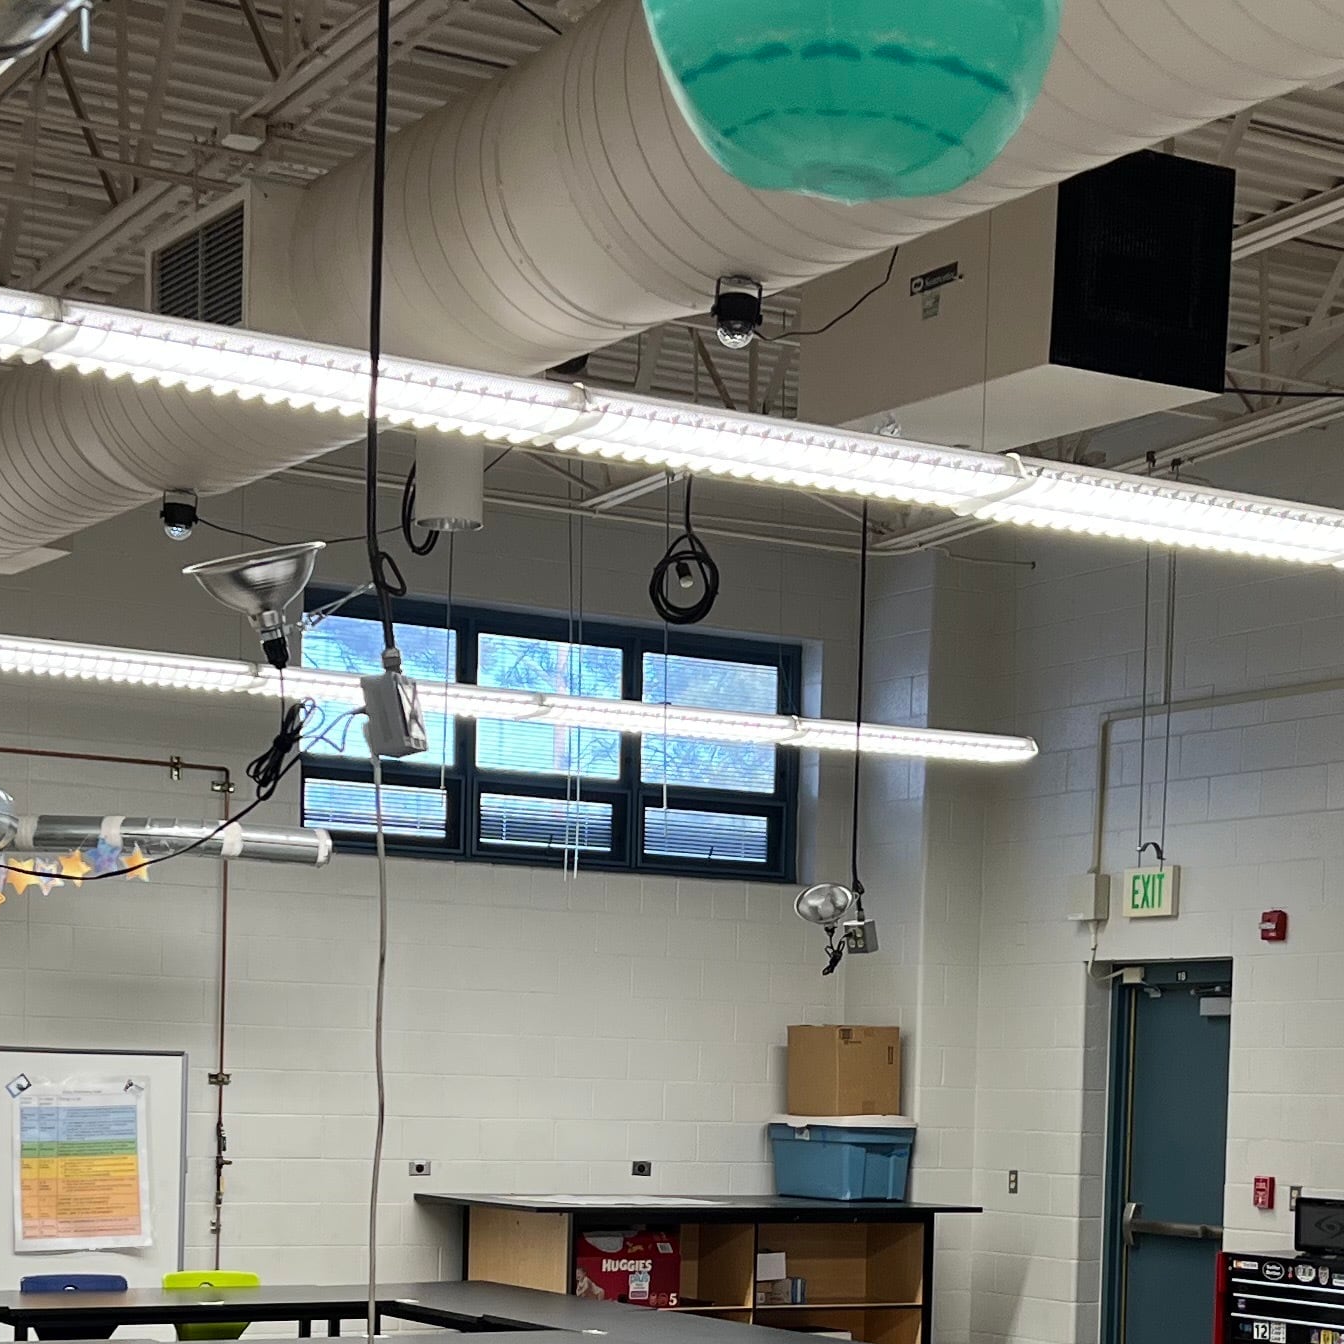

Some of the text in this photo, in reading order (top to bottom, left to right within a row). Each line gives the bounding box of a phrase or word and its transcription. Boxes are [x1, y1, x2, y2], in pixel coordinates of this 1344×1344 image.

[1131, 873, 1165, 909] EXIT
[602, 1259, 653, 1272] HUGGIES
[668, 1293, 678, 1306] 5
[1255, 1324, 1267, 1339] 12
